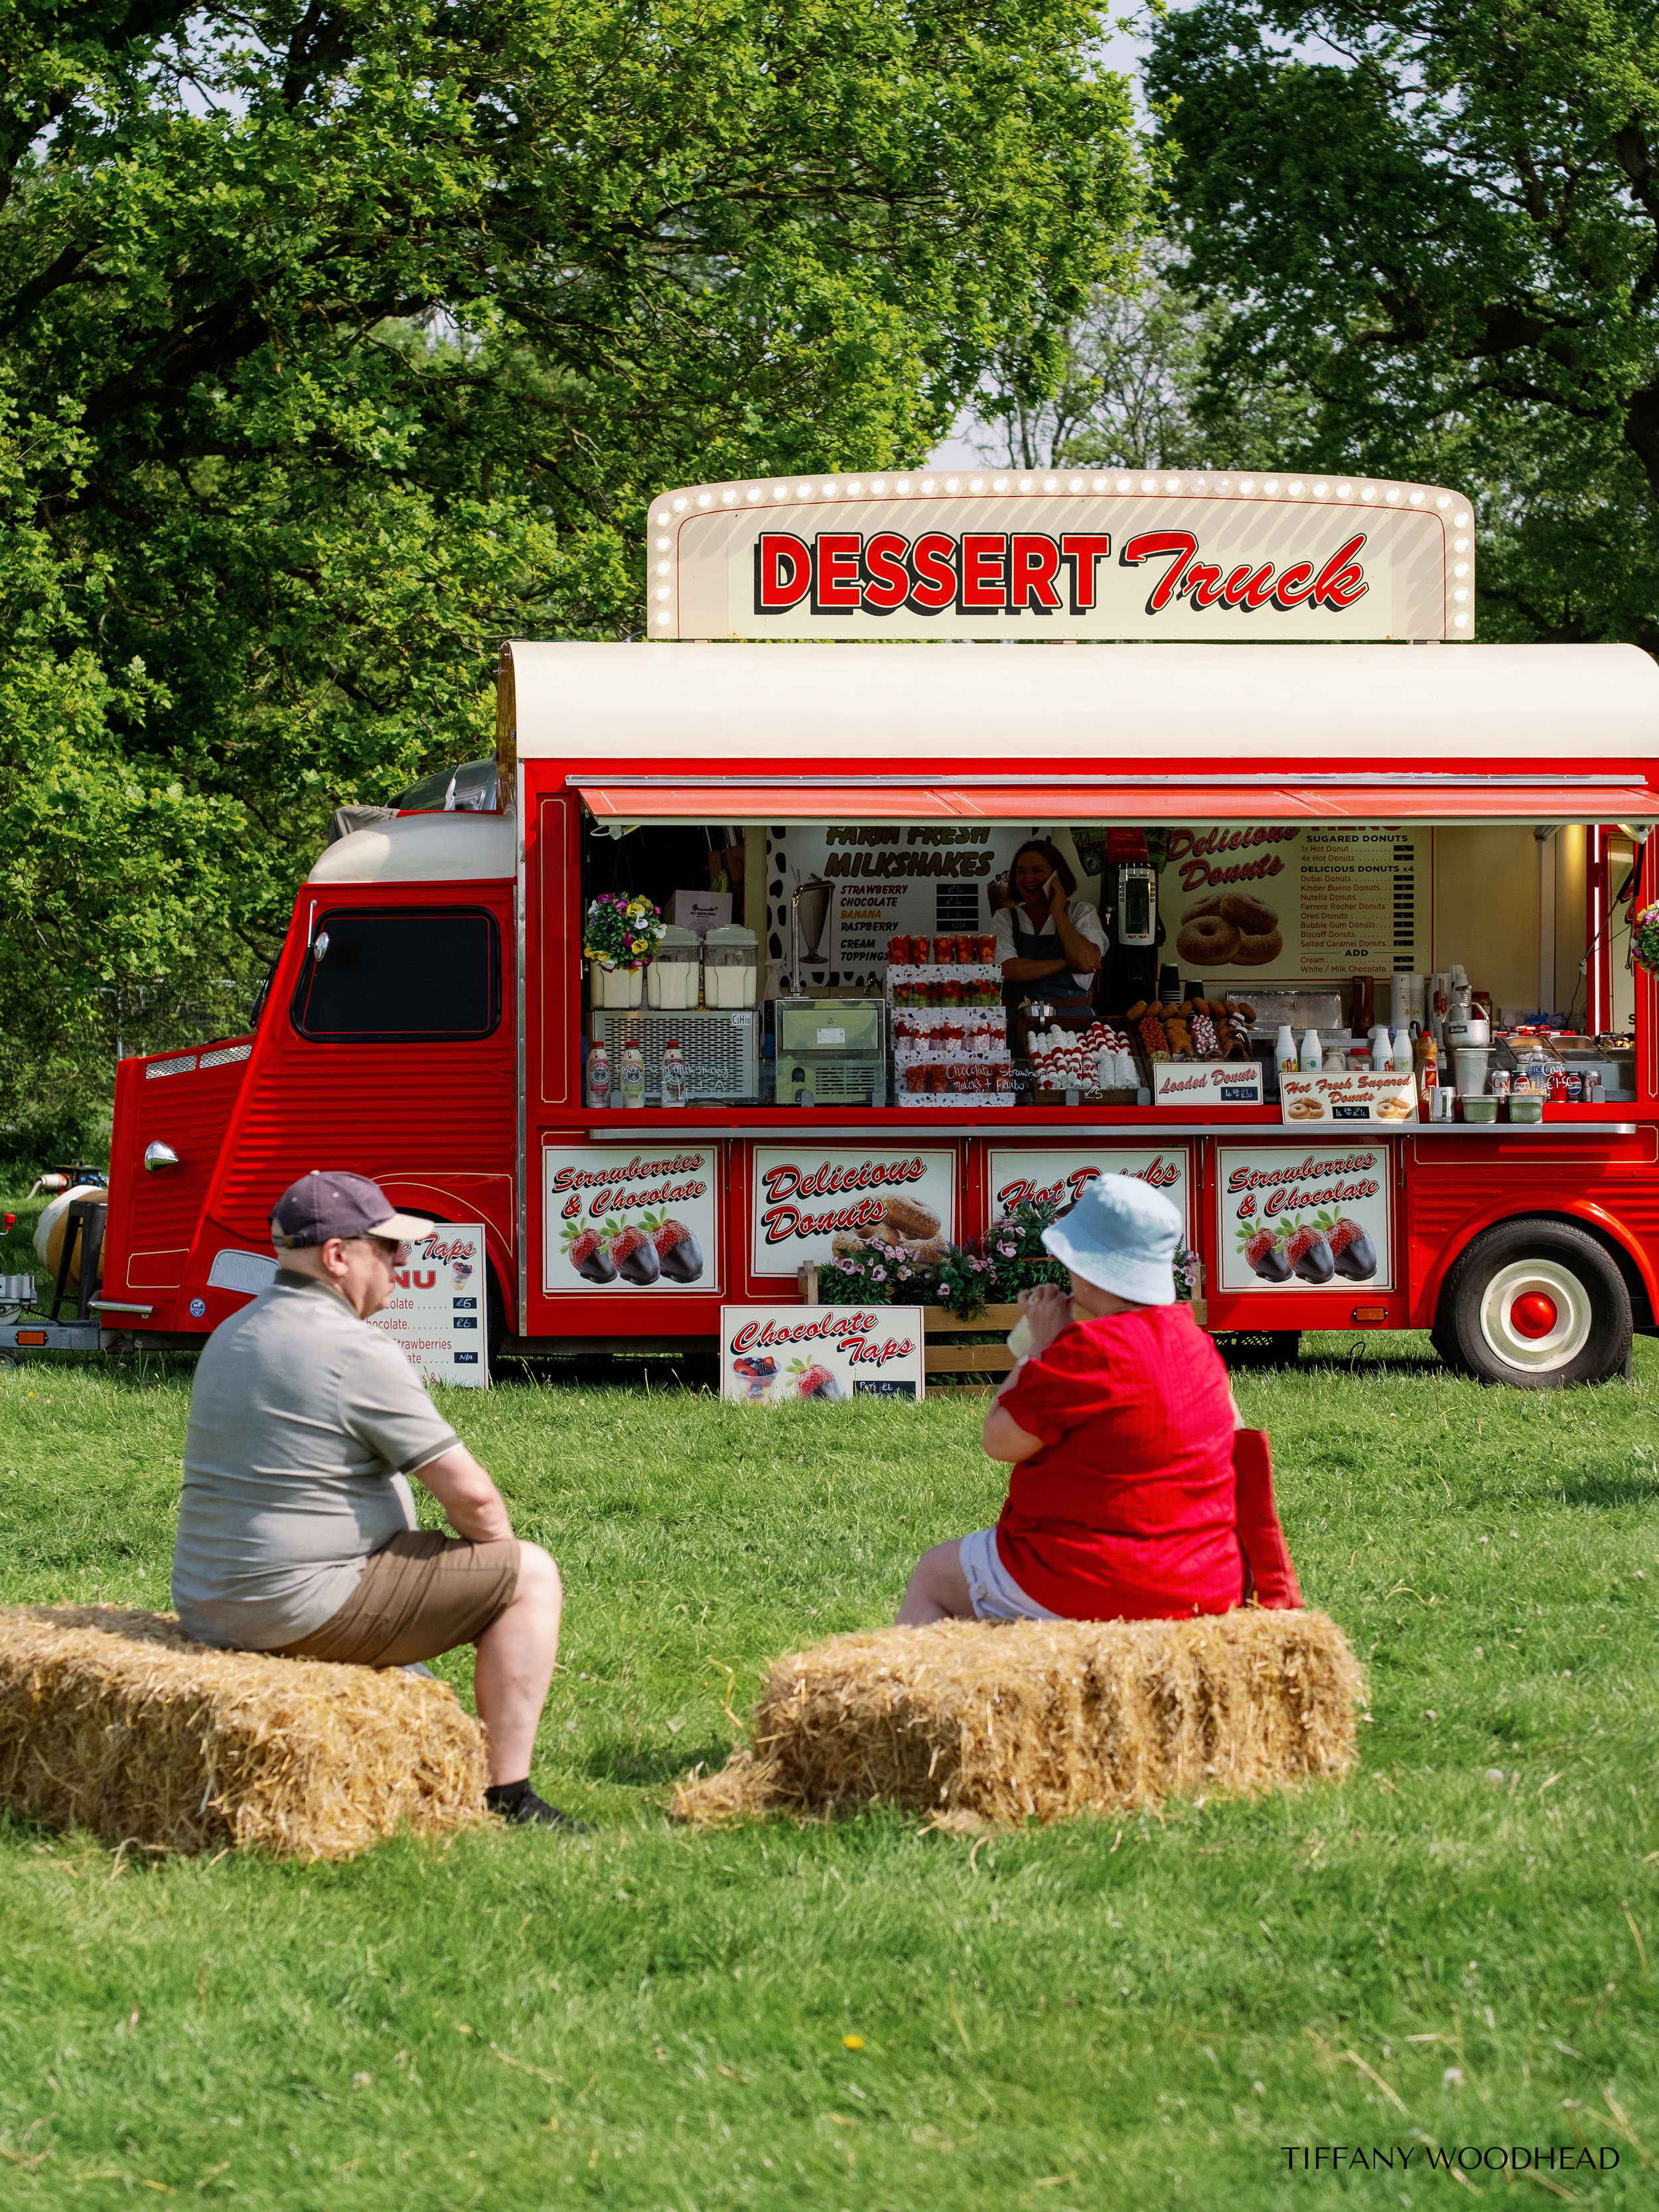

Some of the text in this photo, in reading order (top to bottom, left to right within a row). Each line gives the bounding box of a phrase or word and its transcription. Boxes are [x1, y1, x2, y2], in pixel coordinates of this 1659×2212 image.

[754, 530, 1368, 616] DESSERT Truck
[1169, 826, 1301, 861] Delicious
[824, 851, 995, 878] MILKSHAKES
[1179, 853, 1285, 892] Donuts
[841, 885, 908, 894] STRAWBERRY
[841, 897, 898, 907] CHOCOLATE
[841, 910, 881, 919] BANANA
[841, 922, 899, 932] RASPBERRY
[841, 939, 875, 948] CREAM
[841, 952, 889, 961] TOPPINGS
[1159, 1068, 1258, 1094] Loaded Donuts
[1284, 1074, 1411, 1094] Hot Fresh Sugared
[1328, 1091, 1376, 1104] Donuts
[551, 1153, 705, 1193] Strawberries
[762, 1156, 927, 1205] Delicious
[1227, 1153, 1377, 1194] Strawberries
[561, 1180, 707, 1219] & Chocolate
[997, 1177, 1066, 1215] Hot
[1236, 1179, 1380, 1219] & Chocolate
[760, 1197, 889, 1245] Donuts
[415, 1232, 476, 1266] Taps
[456, 1298, 472, 1308] £6
[457, 1318, 471, 1328] £6
[730, 1311, 879, 1355] Chocolate
[836, 1335, 916, 1367] Taps
